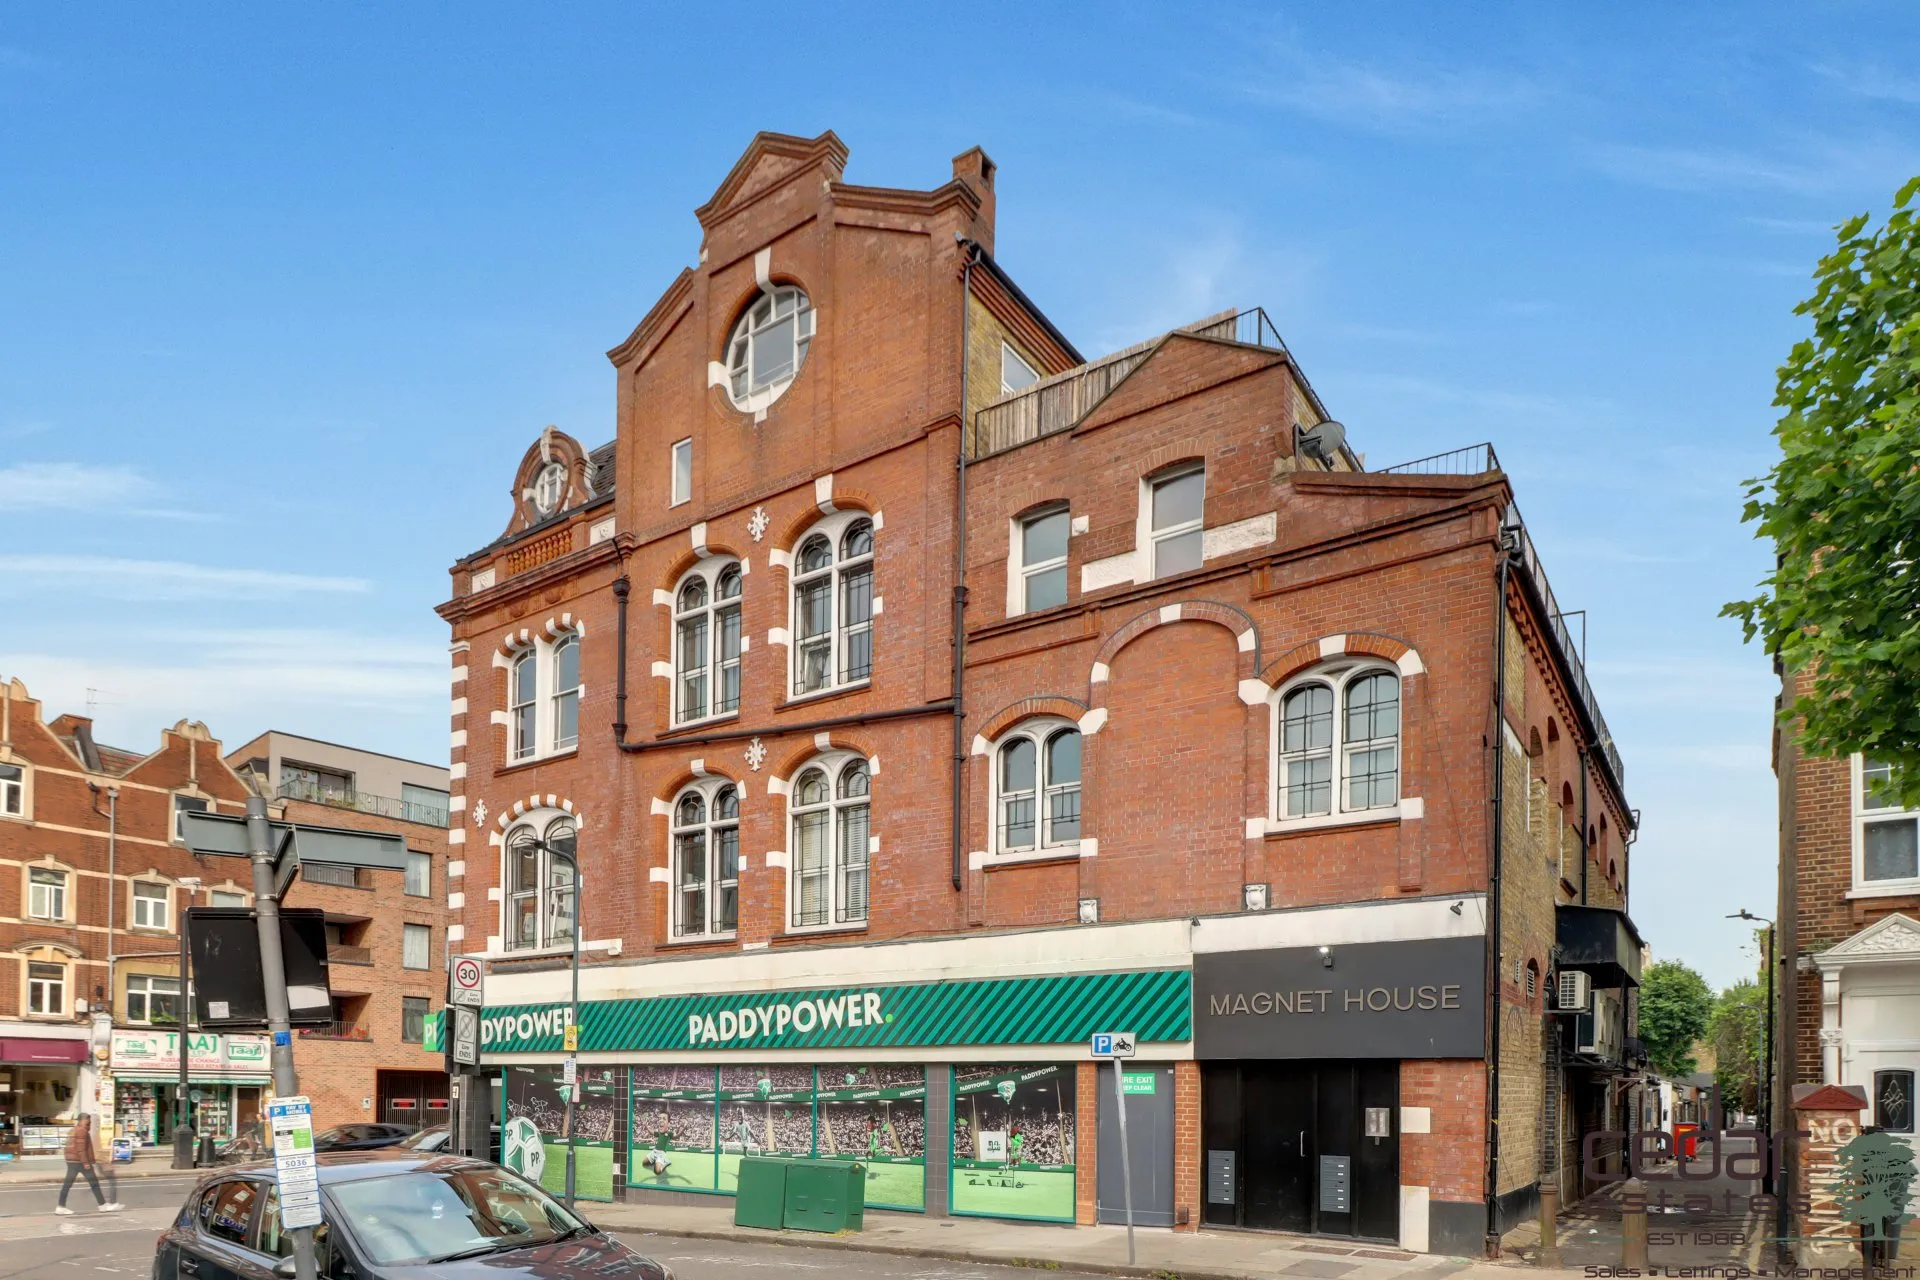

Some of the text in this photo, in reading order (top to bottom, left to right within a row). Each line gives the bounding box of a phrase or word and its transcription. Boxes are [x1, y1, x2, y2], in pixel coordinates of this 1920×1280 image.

[460, 969, 476, 980] 30
[1210, 984, 1461, 1016] MAGNET HOUSE
[1098, 1037, 1109, 1052] P
[459, 1051, 472, 1059] ENDS
[960, 1080, 991, 1091] PADDYPOWER
[1808, 1118, 1858, 1143] NO
[285, 1159, 307, 1168] 5036
